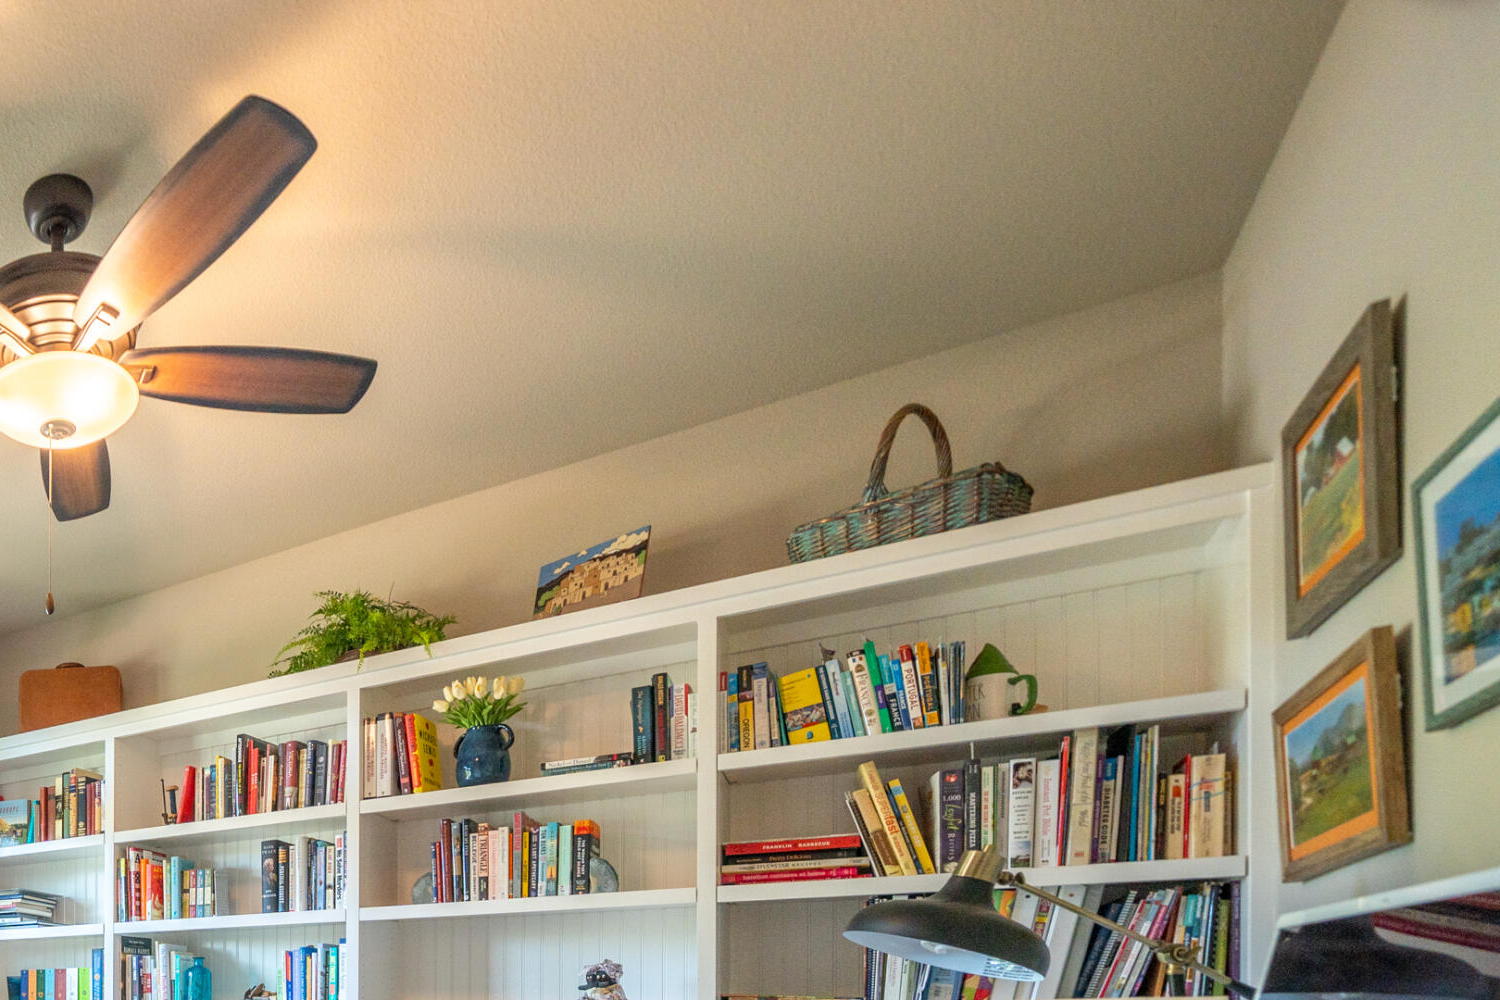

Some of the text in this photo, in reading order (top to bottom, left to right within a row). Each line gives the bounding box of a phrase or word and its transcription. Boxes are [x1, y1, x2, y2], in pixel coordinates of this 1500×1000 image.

[856, 672, 873, 708] FRANCE
[898, 689, 906, 710] FRANCE
[904, 668, 917, 710] PORTUGAL
[923, 675, 934, 711] PORTUGAL
[675, 694, 684, 749] DAVID BALDACCI
[889, 698, 902, 727] FRANCE
[1100, 787, 1112, 845] DIABETES CODE
[337, 849, 342, 858] We
[479, 839, 488, 874] TRIANGLE
